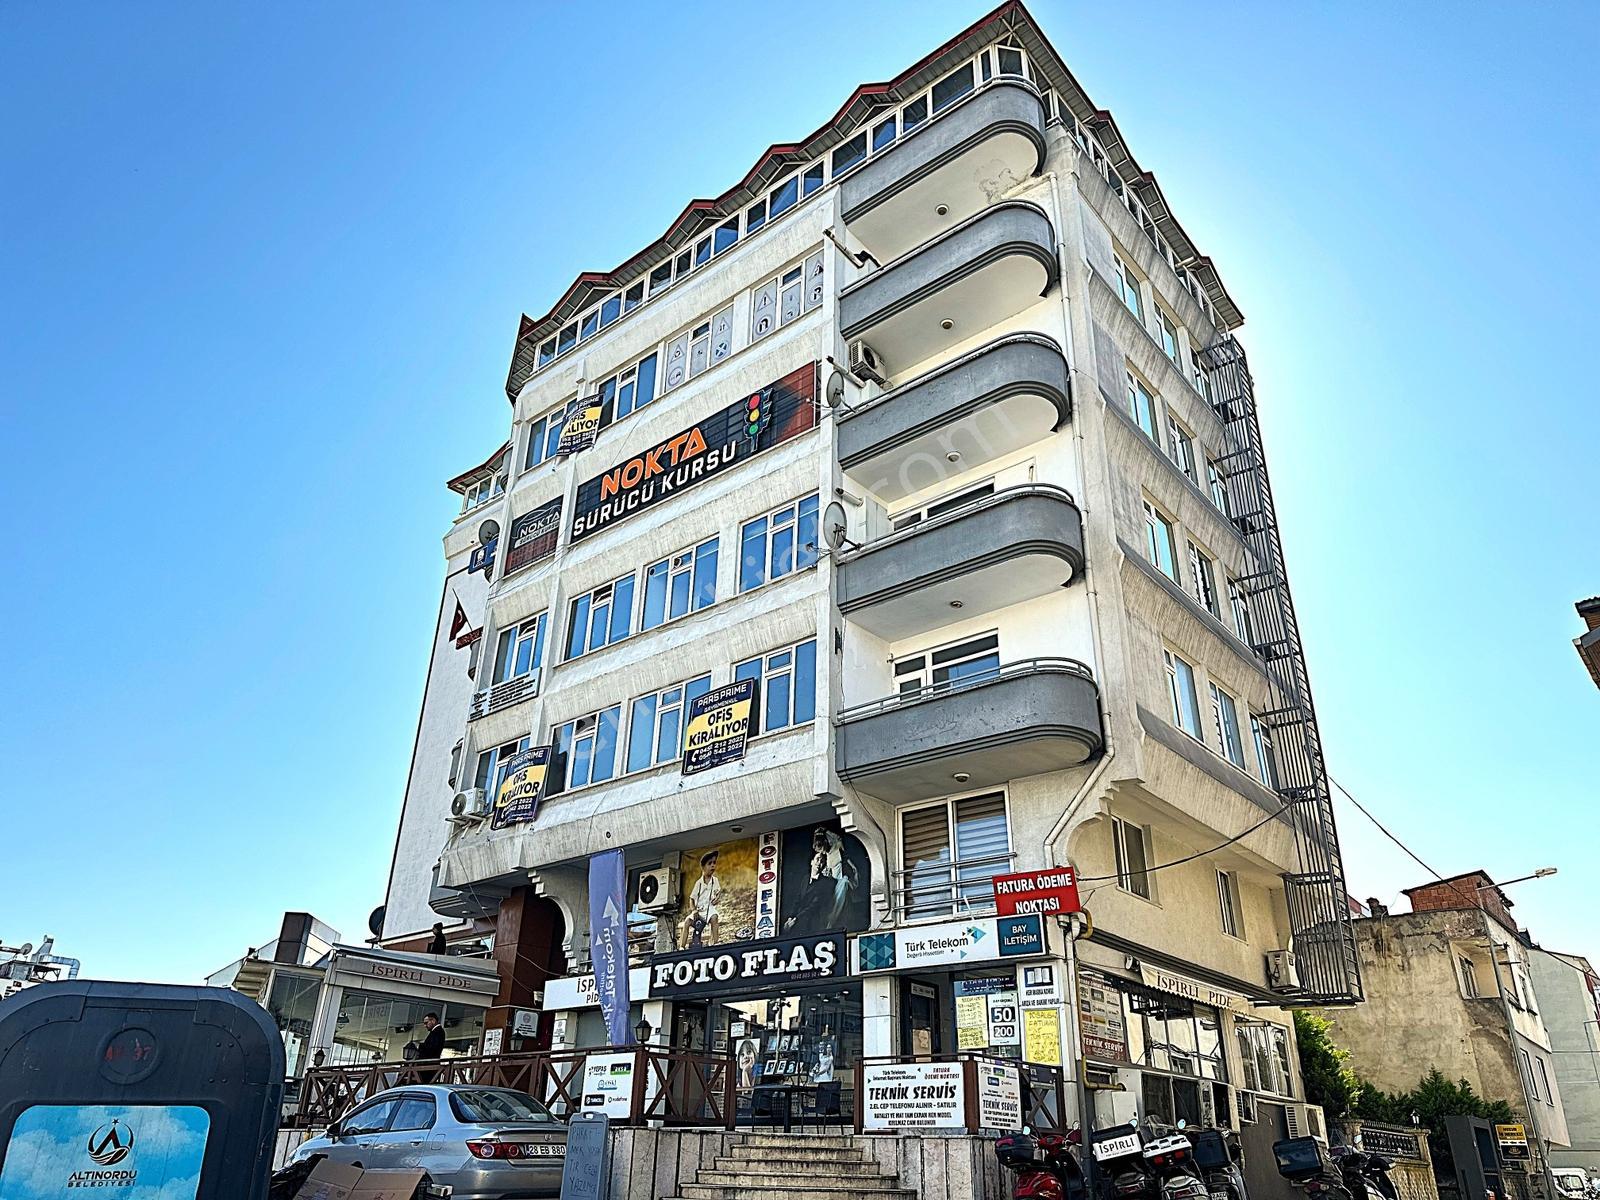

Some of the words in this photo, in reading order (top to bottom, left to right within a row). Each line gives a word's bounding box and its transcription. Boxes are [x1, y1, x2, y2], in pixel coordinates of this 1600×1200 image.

[600, 427, 707, 502] NOKTA
[573, 481, 655, 537] SÜRÜCÜ
[661, 440, 737, 494] KURSU
[519, 511, 561, 539] NOKTA
[697, 693, 719, 709] PARS
[719, 683, 747, 700] PRIME
[727, 741, 743, 751] 2022
[728, 734, 744, 744] 2022
[758, 832, 778, 885] FOTO
[996, 878, 1036, 895] FATURA
[1036, 873, 1073, 890] ÖDEME
[1015, 896, 1060, 915] NOKTASI
[1011, 924, 1027, 934] BAY
[904, 941, 926, 952] Türk
[928, 936, 969, 950] Telekom
[1004, 934, 1038, 947] İLETİŞİM
[653, 953, 738, 989] FOTO
[740, 940, 837, 978] FLAŞ
[371, 963, 424, 982] İSPİRLİ
[438, 975, 473, 989] PİDE
[1156, 972, 1200, 998] İSPİRLİ
[994, 1007, 1012, 1022] 50
[994, 1026, 1013, 1037] 200
[869, 1082, 910, 1100] TEKNİK
[913, 1081, 957, 1099] SERVİS
[529, 1145, 539, 1155] 28
[540, 1145, 550, 1155] EB
[68, 1170, 138, 1181] ALTINORDU
